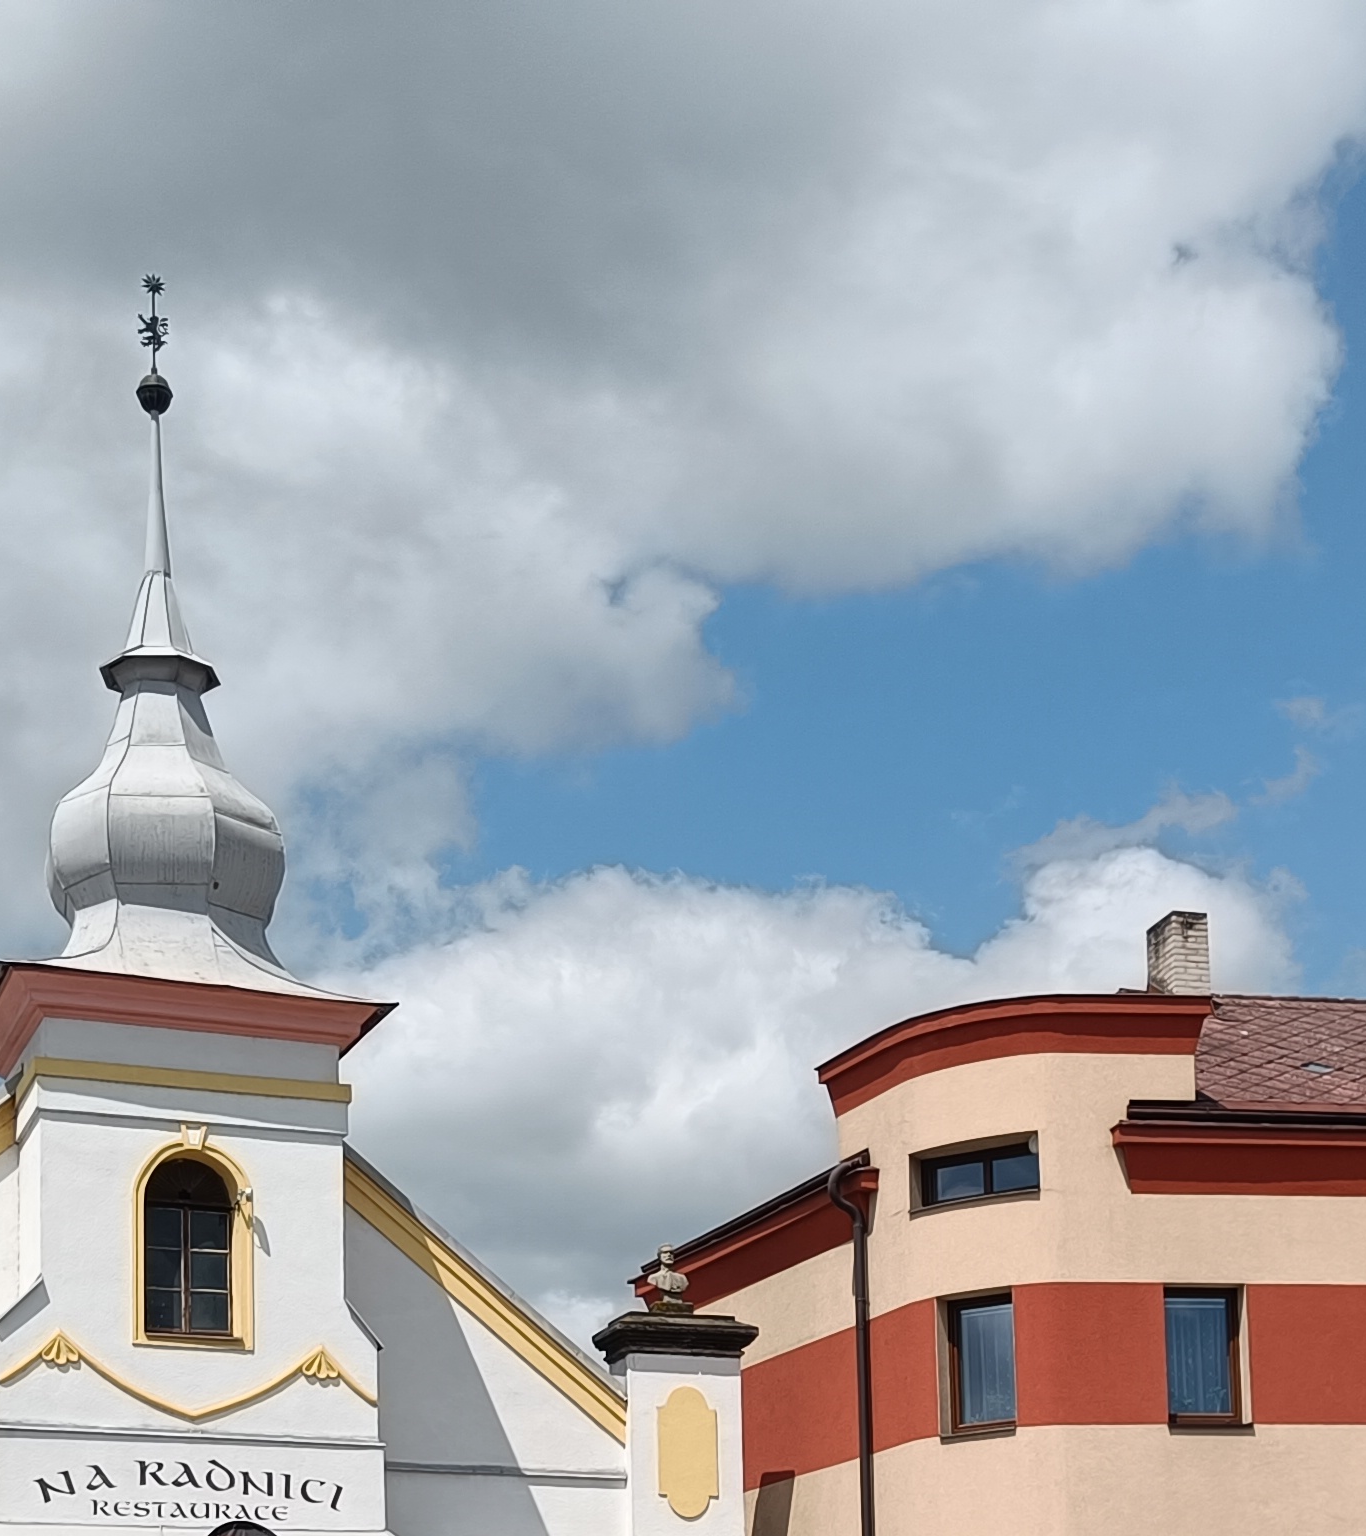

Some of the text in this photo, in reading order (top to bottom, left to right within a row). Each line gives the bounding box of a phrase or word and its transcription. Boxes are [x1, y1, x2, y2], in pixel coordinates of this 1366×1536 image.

[33, 1459, 344, 1512] NA RADNICI
[91, 1499, 289, 1521] RESTAURACE
